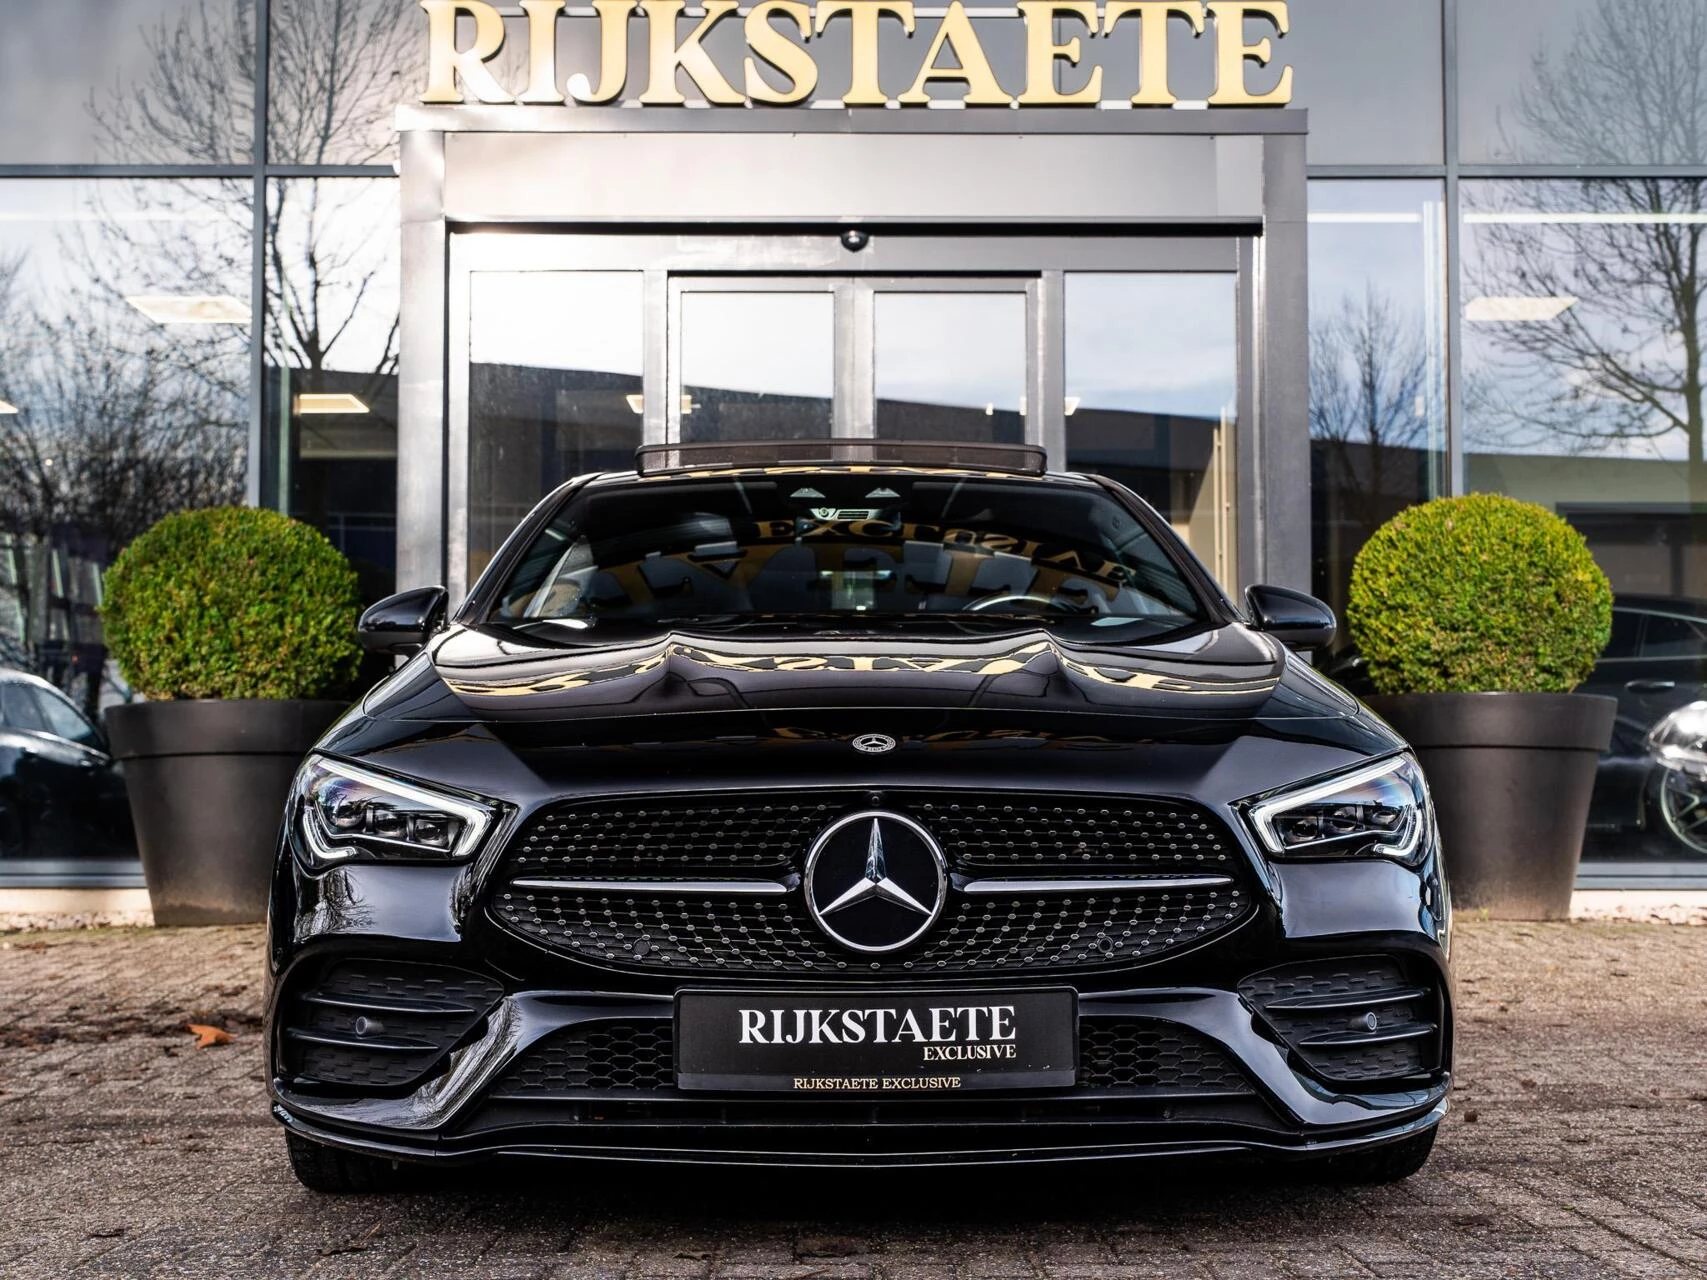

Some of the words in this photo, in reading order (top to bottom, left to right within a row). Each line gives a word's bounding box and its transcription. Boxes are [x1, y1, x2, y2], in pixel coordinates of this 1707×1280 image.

[419, 0, 1293, 106] RIJKSTAETE
[738, 1005, 1017, 1044] RIJKSTAETE
[923, 1044, 1017, 1061] EXCLUSIVE
[793, 1077, 878, 1090] RIJKSTAETE
[882, 1076, 962, 1089] EXCLUSIVE
